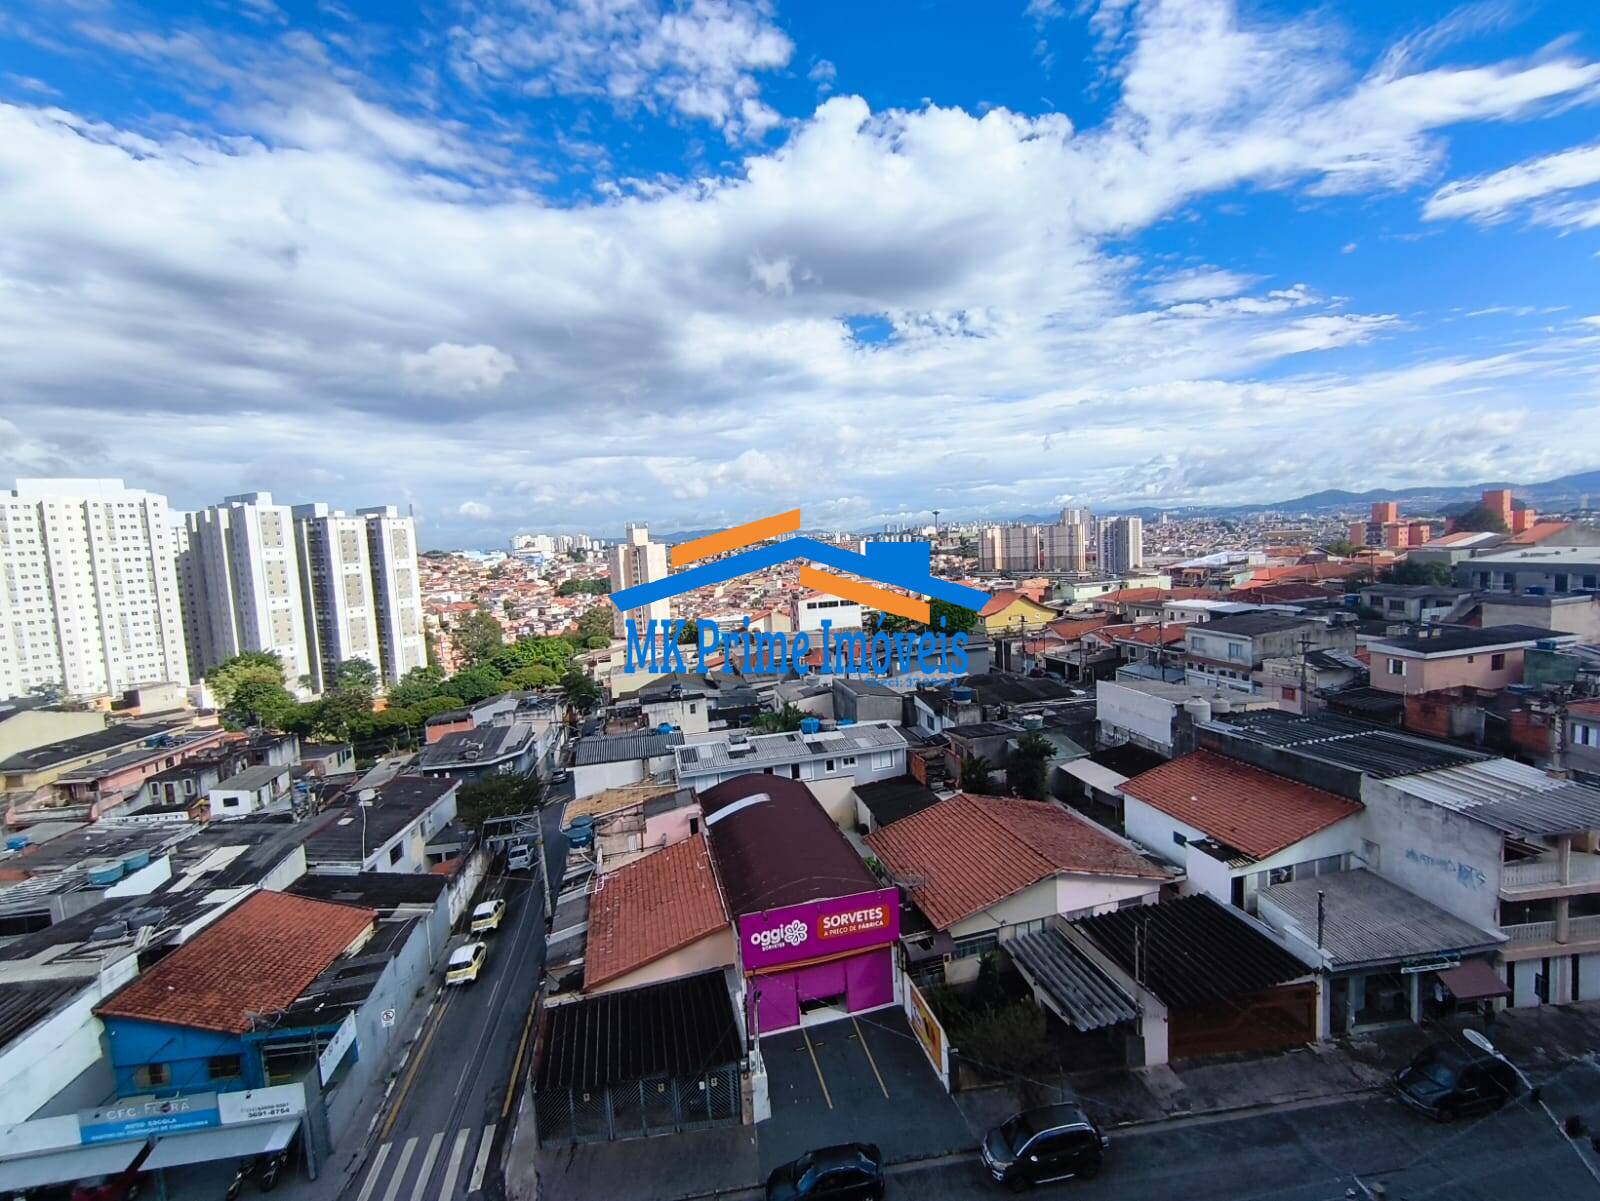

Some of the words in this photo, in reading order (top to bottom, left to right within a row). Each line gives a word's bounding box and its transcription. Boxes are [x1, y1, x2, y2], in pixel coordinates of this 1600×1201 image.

[823, 907, 883, 928] SORVETES
[751, 924, 784, 947] oggi
[829, 926, 849, 937] PREÇO
[849, 924, 857, 933] DE
[108, 1108, 137, 1120] CFC
